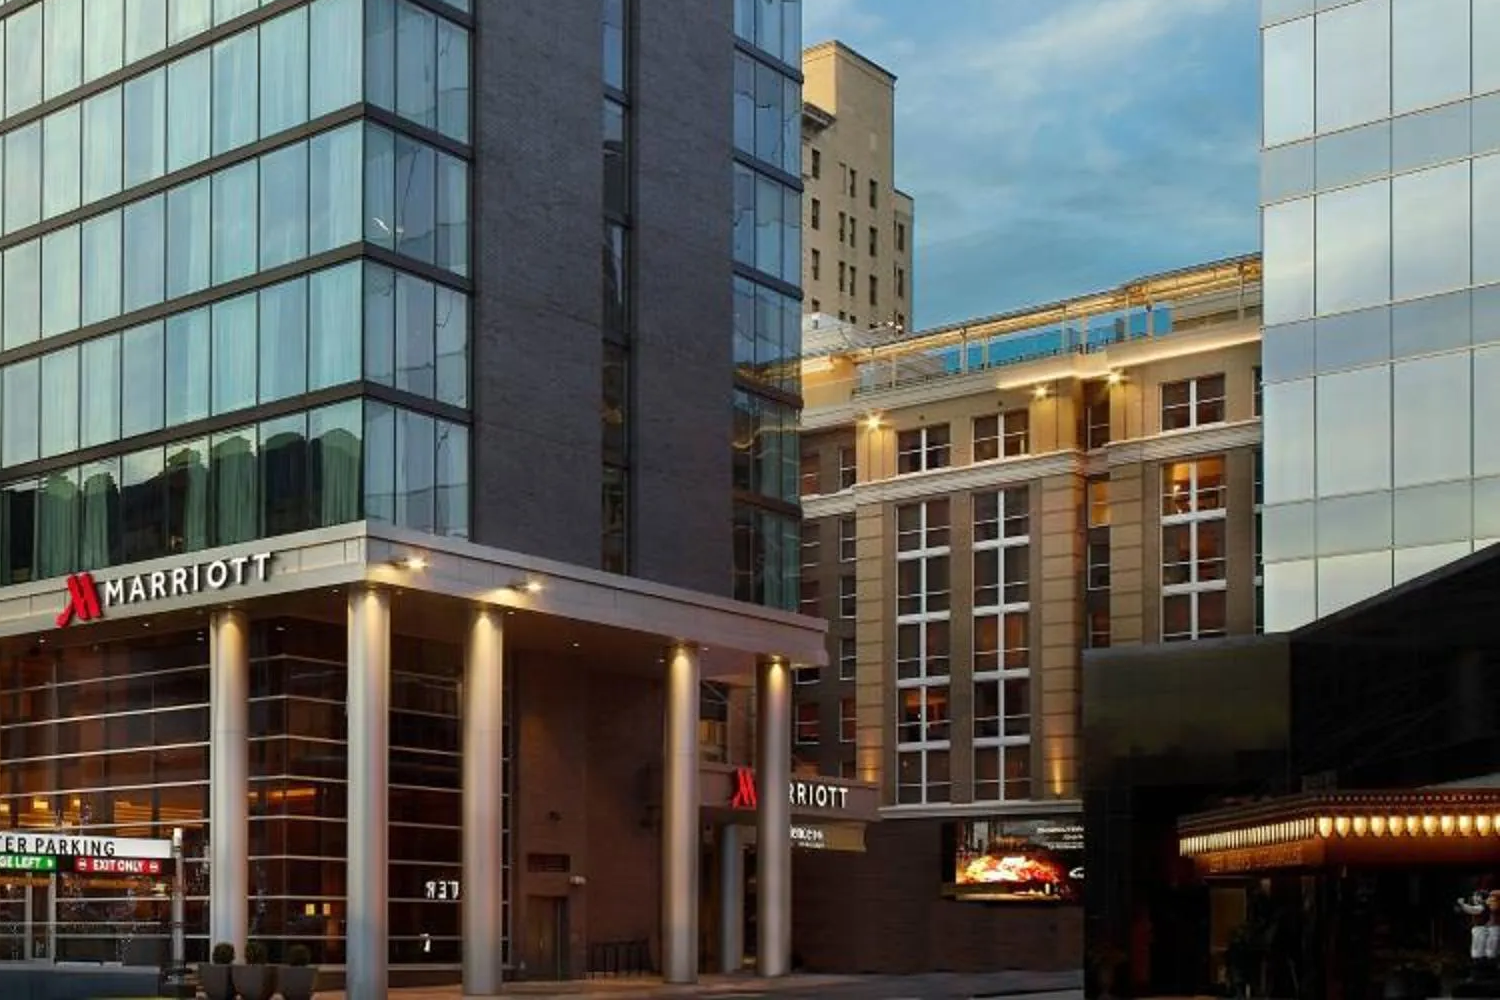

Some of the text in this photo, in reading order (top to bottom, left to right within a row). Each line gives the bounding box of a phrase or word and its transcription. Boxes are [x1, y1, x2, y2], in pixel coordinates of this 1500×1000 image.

[105, 552, 271, 606] MARRIOTT
[789, 783, 849, 809] RRIOTT
[35, 837, 115, 857] PARKING
[15, 856, 41, 870] LEFT
[93, 859, 144, 874] EXIT ONLY
